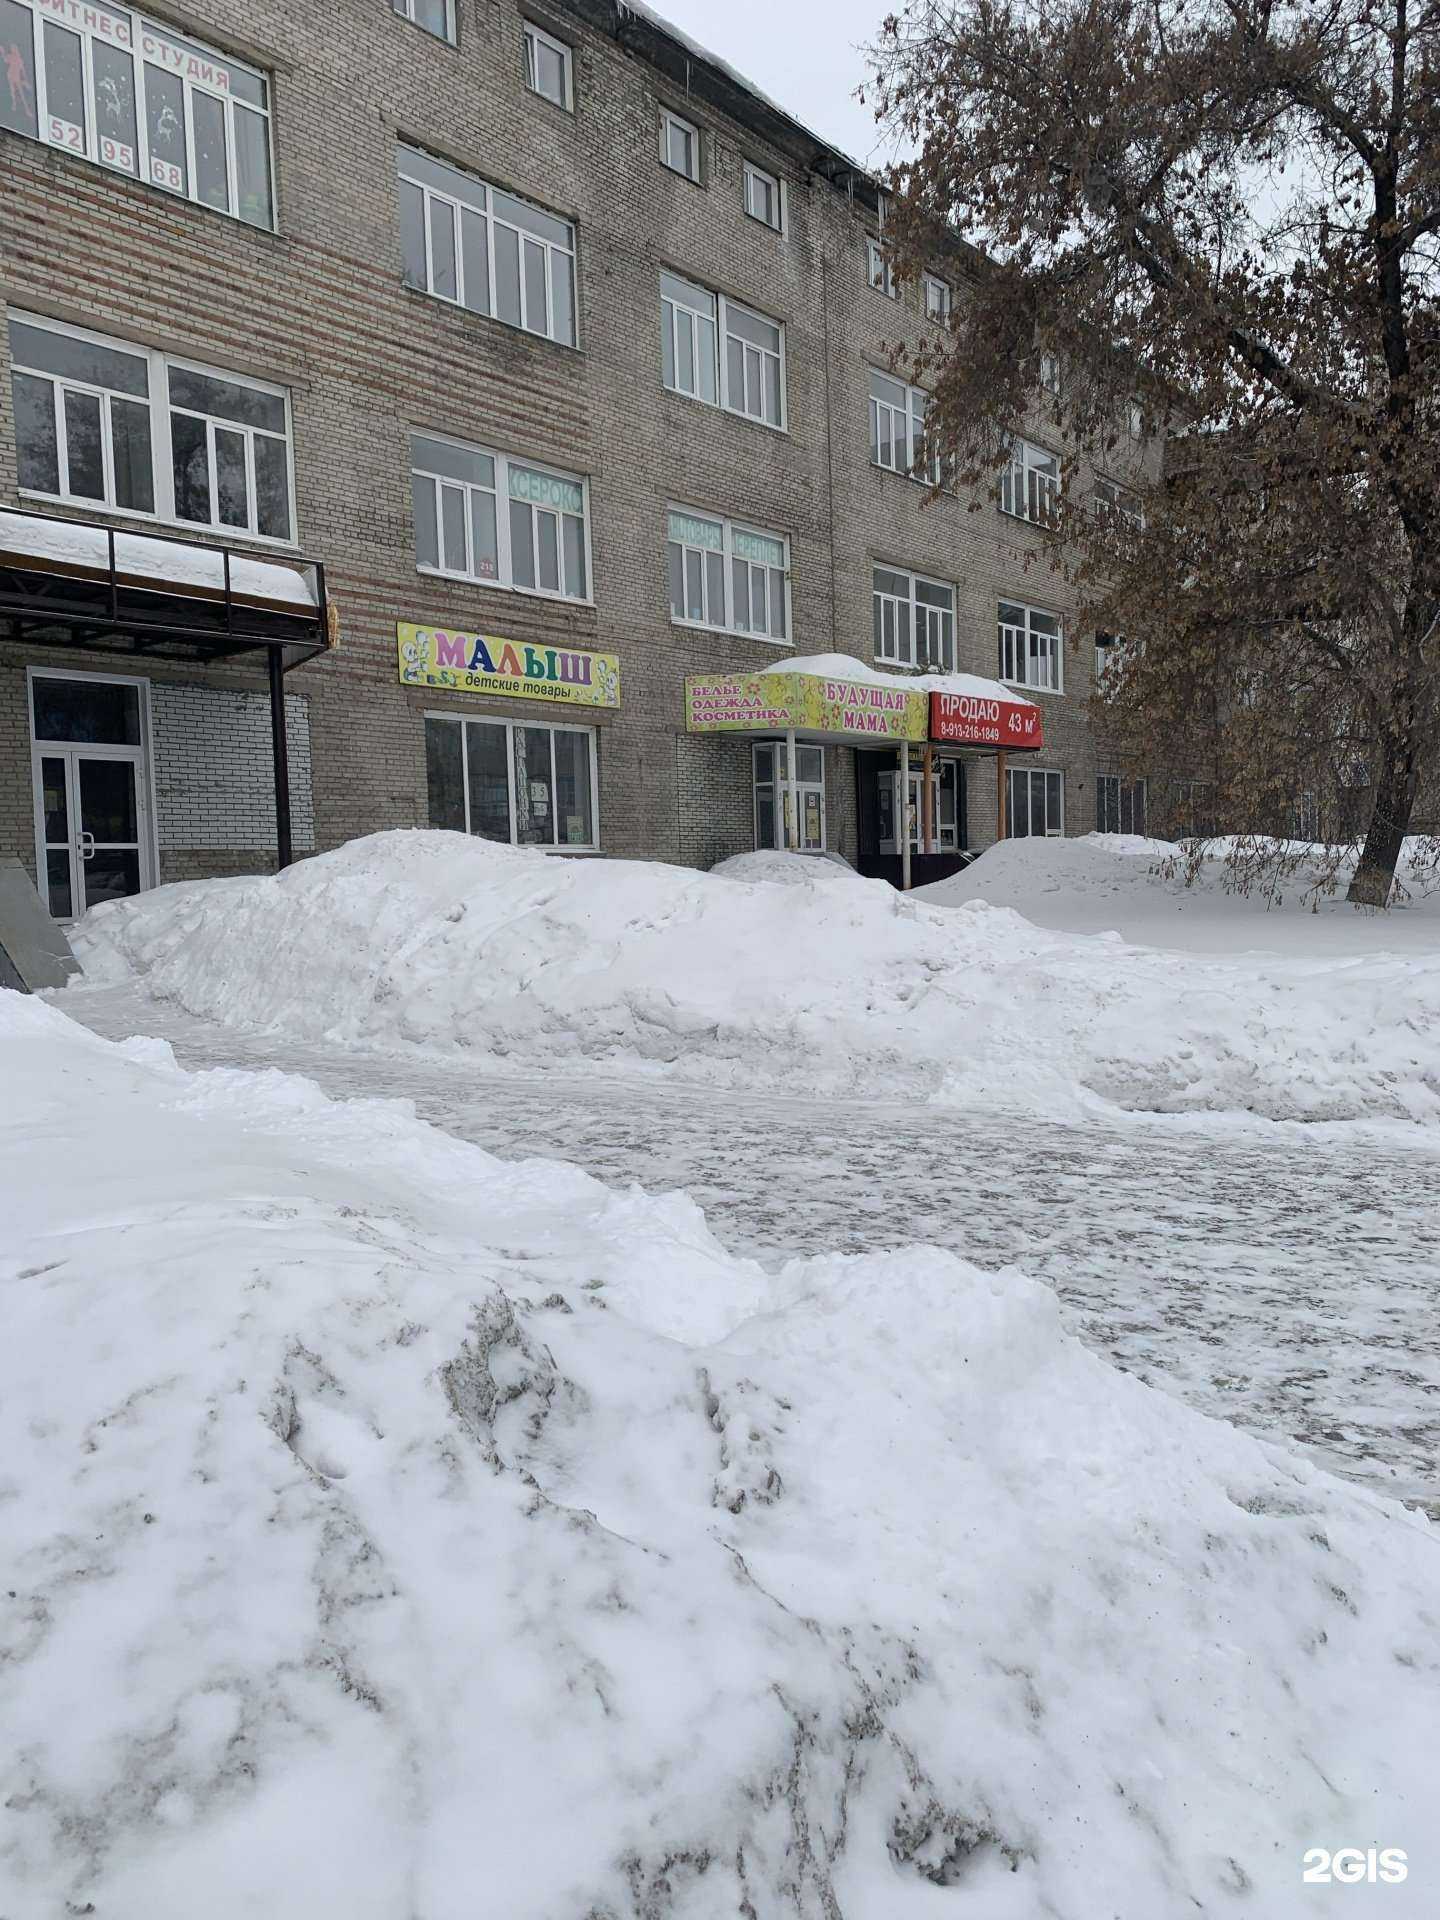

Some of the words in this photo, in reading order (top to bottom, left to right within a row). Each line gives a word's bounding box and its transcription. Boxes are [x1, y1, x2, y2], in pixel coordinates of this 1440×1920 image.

[142, 36, 230, 90] СТУДИЯ
[50, 118, 82, 148] 52
[103, 139, 132, 169] 95
[152, 160, 181, 189] 68
[434, 632, 593, 686] МАЛЫШ
[465, 672, 520, 692] детские
[523, 679, 571, 700] товары
[691, 685, 742, 697] БЕЛЬЕ
[826, 682, 905, 711] БУДУЩАЯ
[691, 697, 763, 710] ОДЕЖДА
[691, 709, 790, 722] КОСМЕТИКА
[940, 694, 1000, 724] ПРОДАЮ
[843, 710, 889, 733] МАМА
[940, 721, 1000, 741] 8-913-216-1849
[1008, 712, 1022, 732] 43
